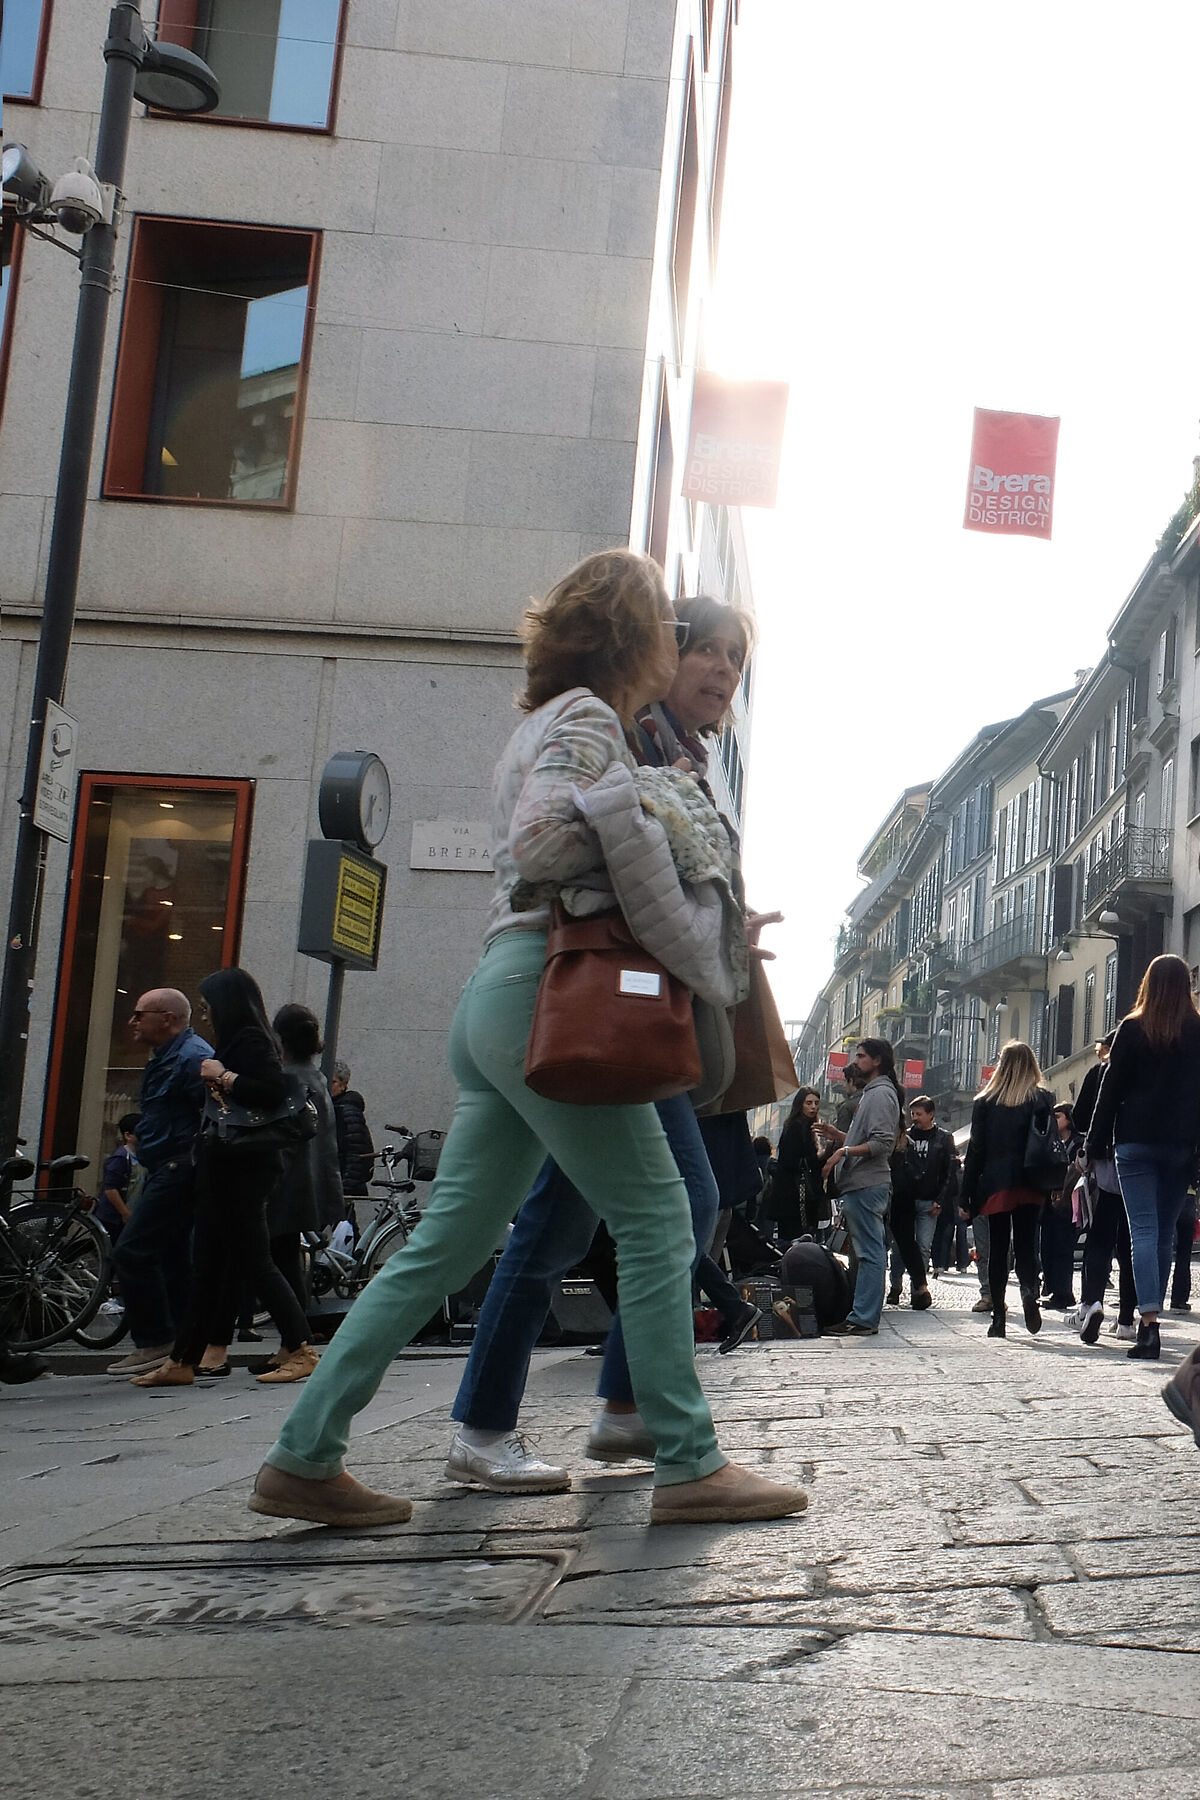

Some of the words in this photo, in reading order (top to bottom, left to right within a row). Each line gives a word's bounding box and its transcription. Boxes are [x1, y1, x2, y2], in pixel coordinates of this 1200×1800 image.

[690, 460, 776, 482] DESIGN
[973, 465, 1050, 494] Brera
[688, 475, 772, 498] DISTRICT
[970, 492, 1050, 512] DESIGN
[969, 507, 1049, 528] DISTRICT
[452, 827, 470, 835] VIA
[428, 846, 490, 859] BRERA
[562, 1287, 592, 1295] CUBE
